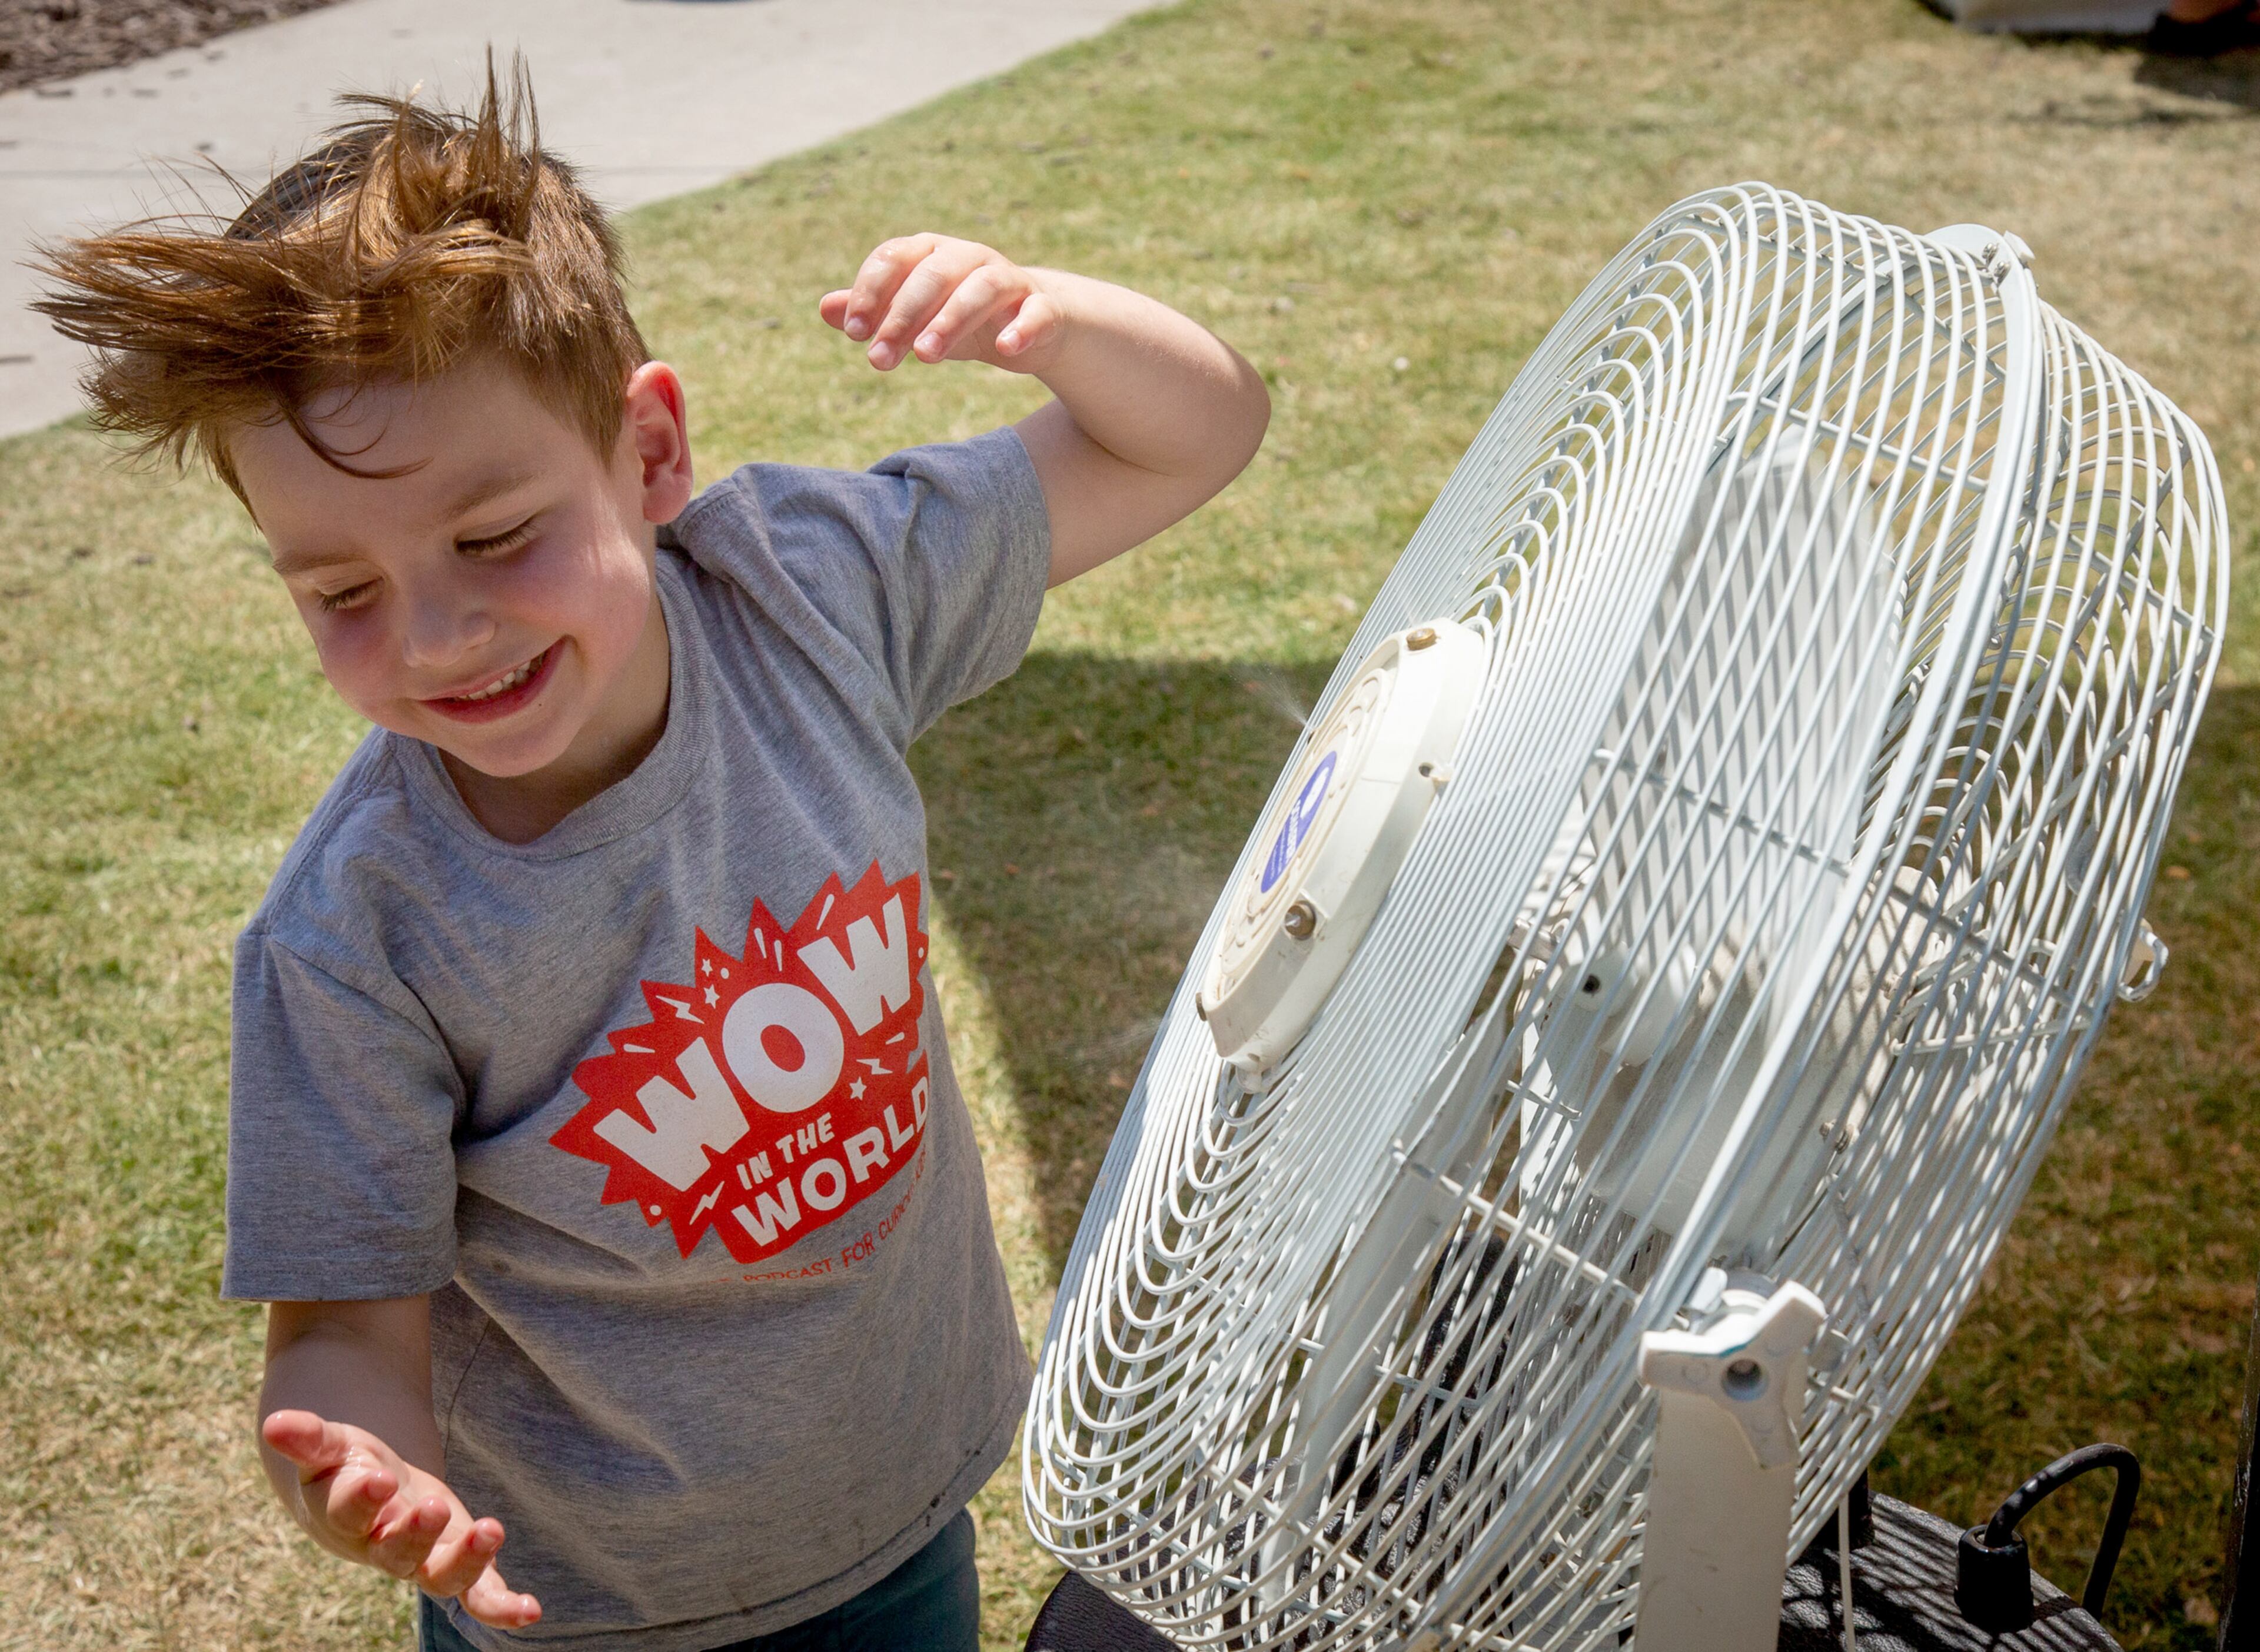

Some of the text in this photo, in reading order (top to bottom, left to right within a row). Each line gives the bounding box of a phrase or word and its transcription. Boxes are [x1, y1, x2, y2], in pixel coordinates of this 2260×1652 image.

[593, 893, 910, 1192] WOW
[732, 1076, 928, 1247] WORLD
[736, 1113, 835, 1190] IN THE
[743, 1258, 832, 1282] PODCAST
[841, 1232, 875, 1268] FOR
